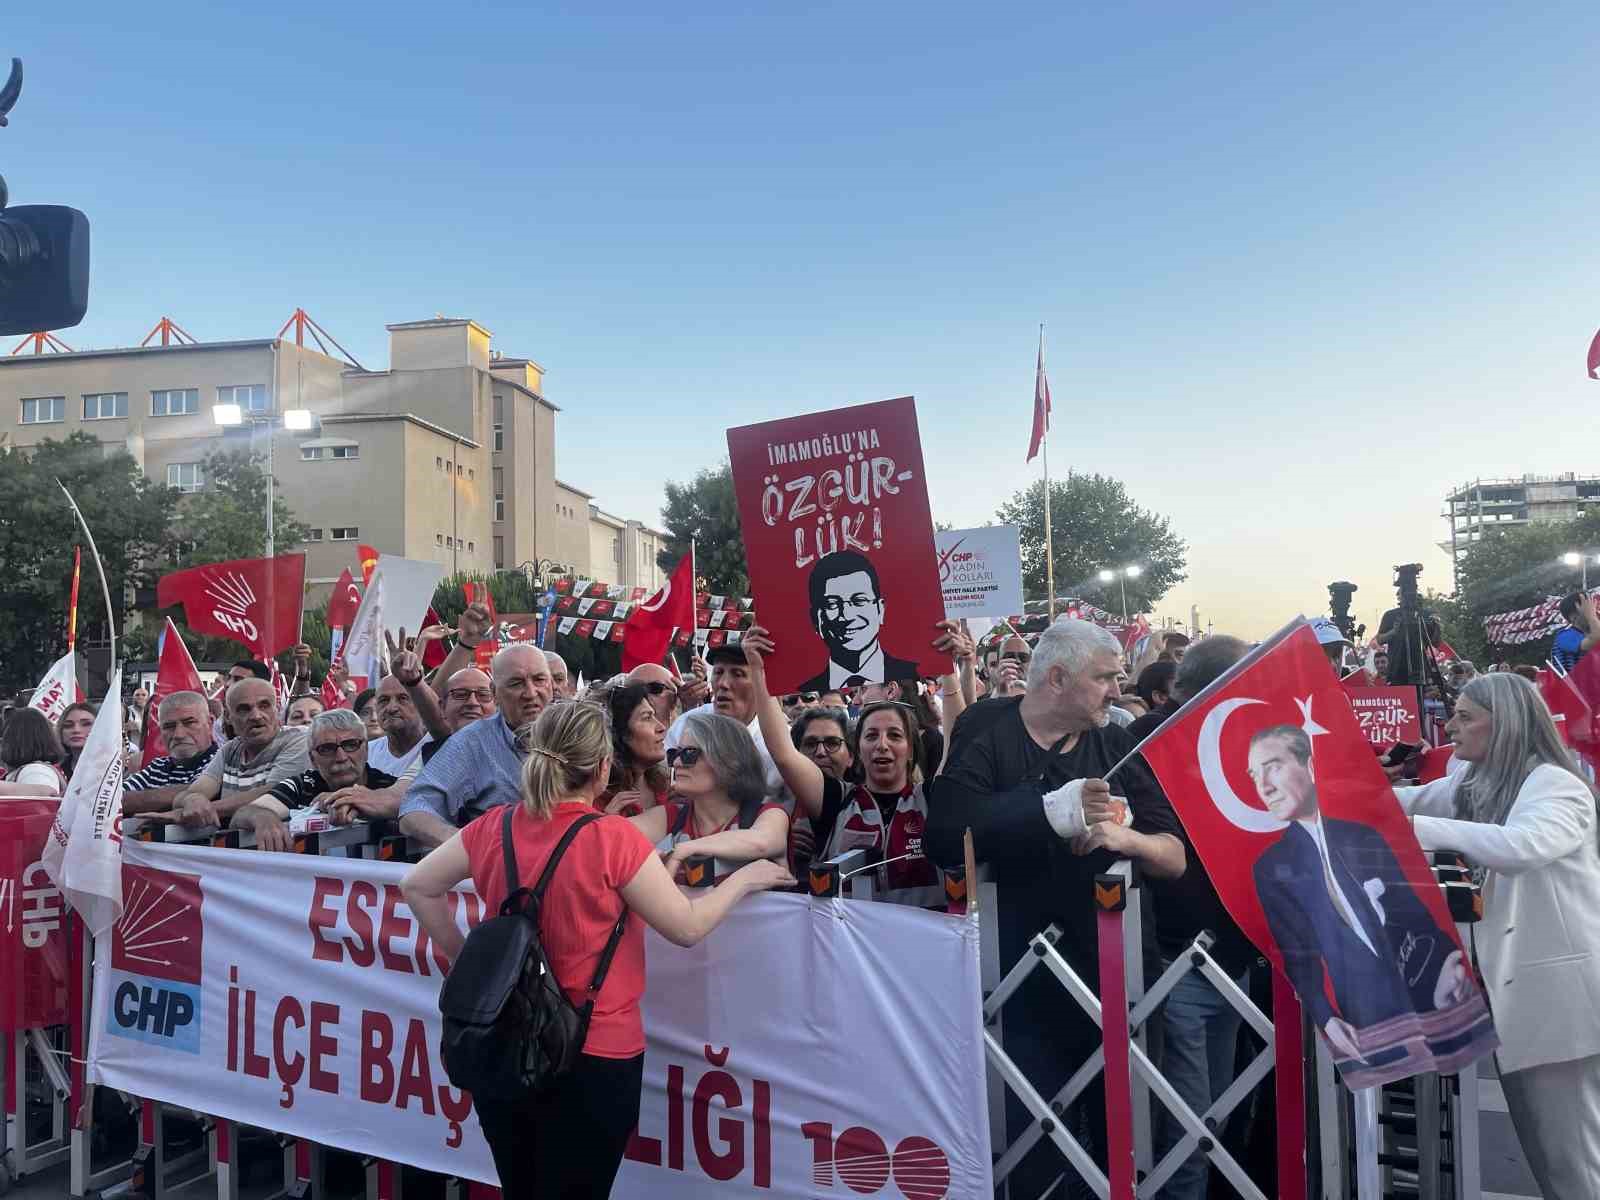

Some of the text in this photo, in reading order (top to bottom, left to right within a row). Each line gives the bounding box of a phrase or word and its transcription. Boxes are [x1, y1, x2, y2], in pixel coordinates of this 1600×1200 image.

[767, 428, 880, 466] İMAMOĞLU'NA
[762, 452, 913, 527] ÖZGÜR-
[795, 507, 883, 569] LÜK!
[951, 552, 973, 562] CHP
[951, 562, 985, 573] KADIN
[114, 980, 194, 1038] CHP
[226, 965, 341, 1109] İLÇE
